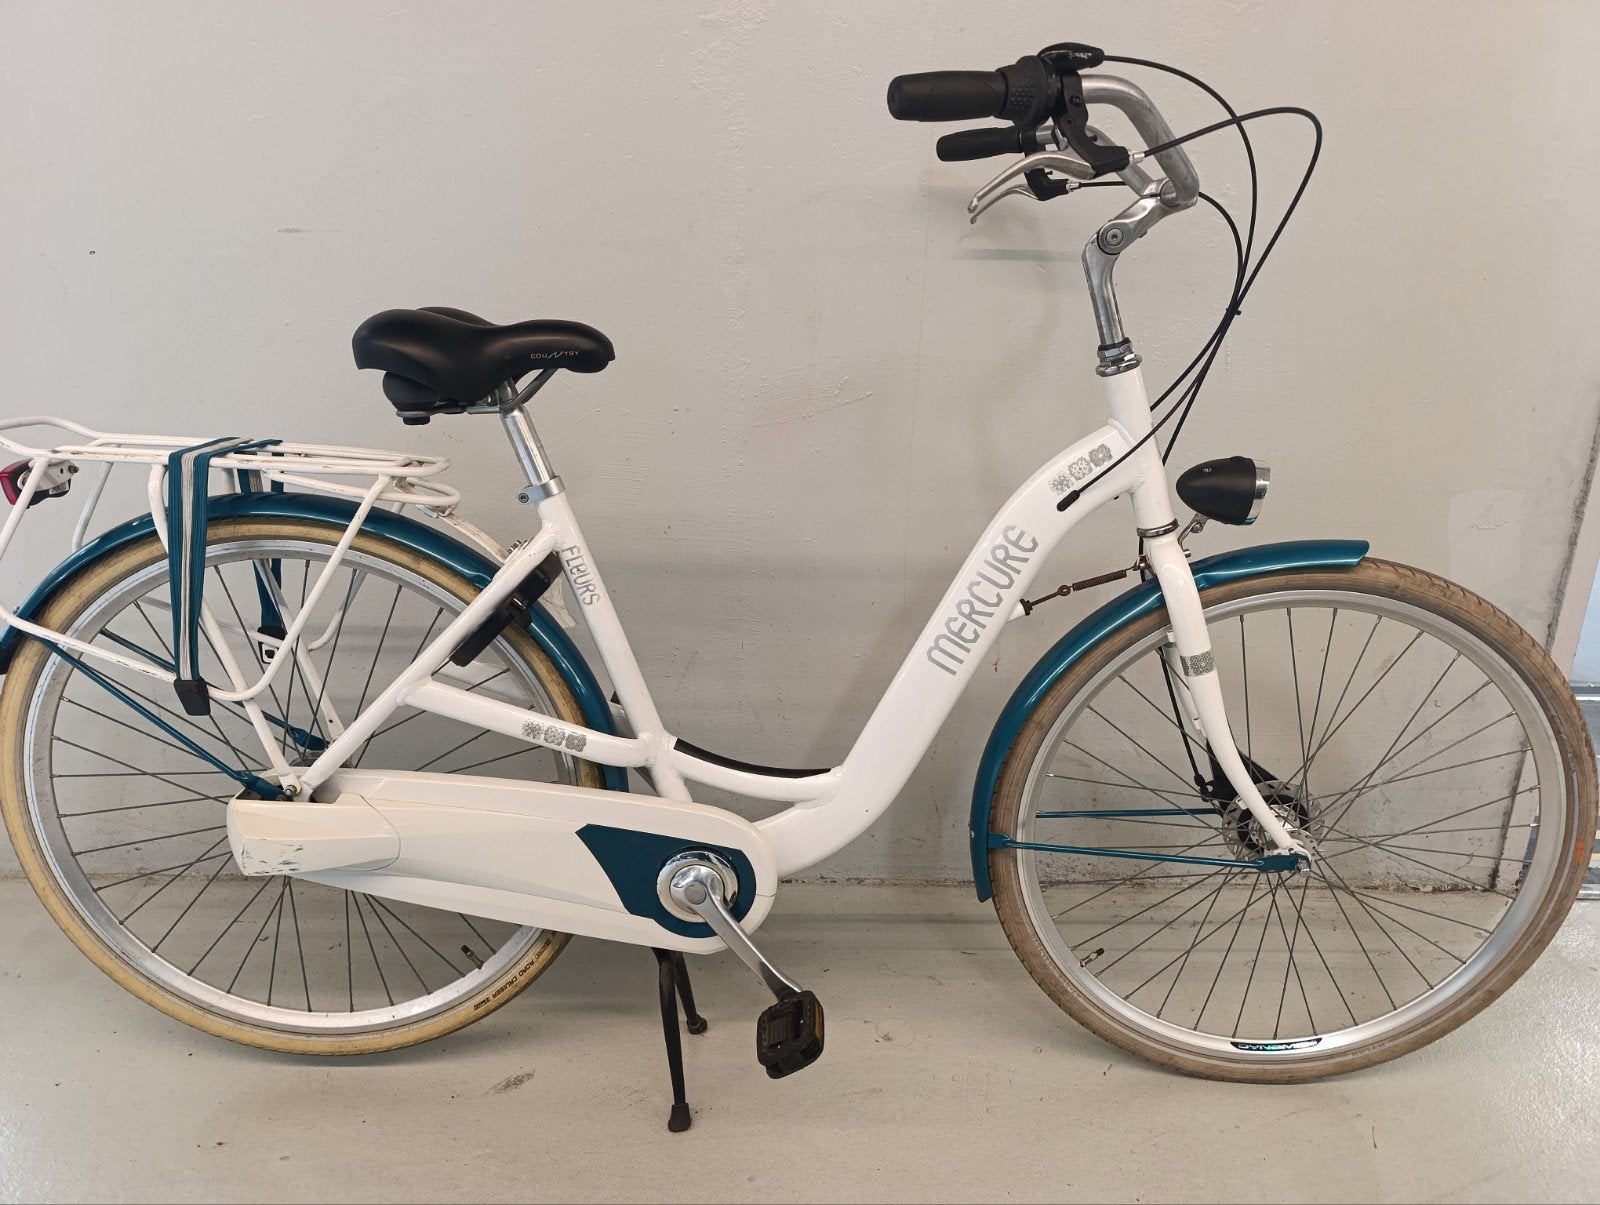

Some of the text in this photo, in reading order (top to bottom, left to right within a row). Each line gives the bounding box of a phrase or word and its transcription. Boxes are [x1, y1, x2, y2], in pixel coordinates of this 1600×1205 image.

[530, 350, 580, 359] COUNTRY
[562, 545, 601, 606] FLEURS
[926, 524, 1039, 676] MERCURE
[492, 975, 518, 999] CRUISER
